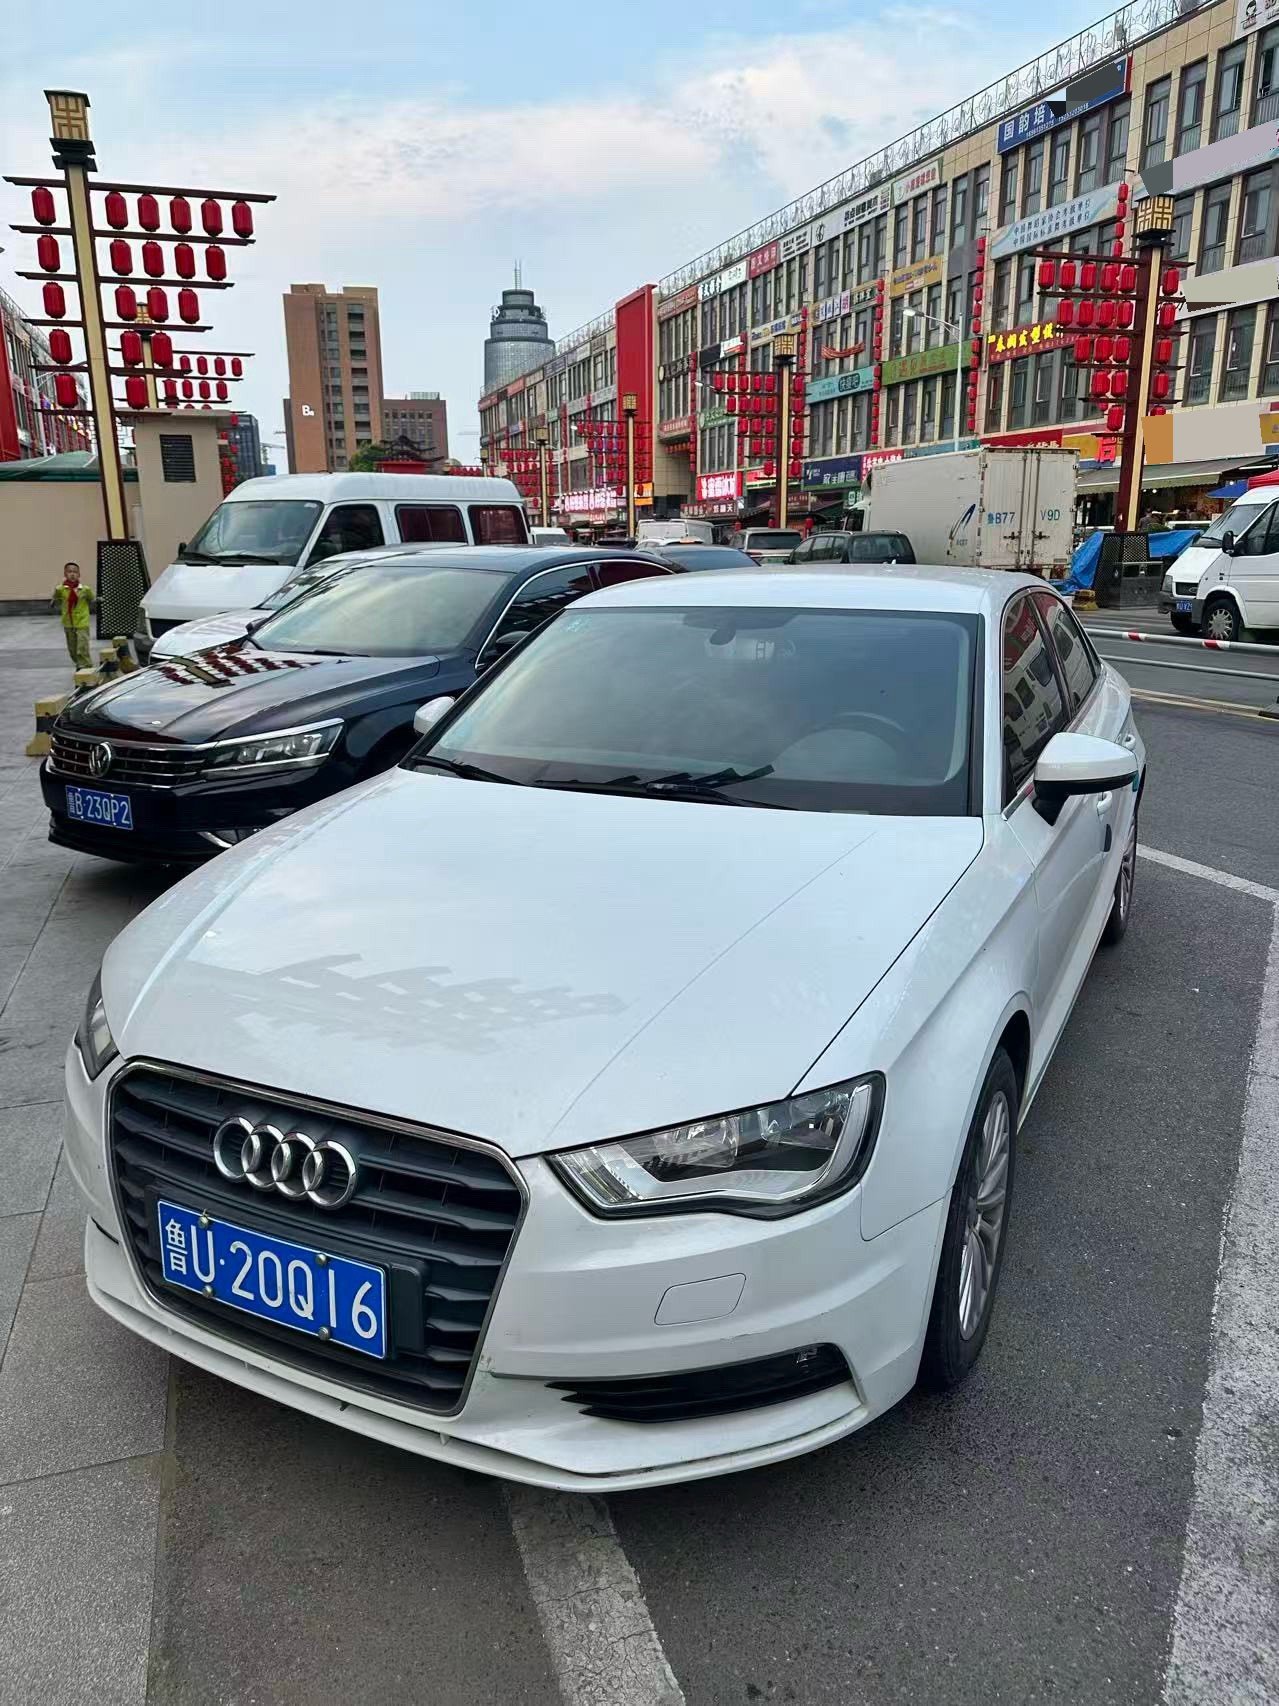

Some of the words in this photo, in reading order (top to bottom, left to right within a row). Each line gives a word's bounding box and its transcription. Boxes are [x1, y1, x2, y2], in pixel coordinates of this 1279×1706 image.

[1004, 104, 1055, 141] 国韵培
[1040, 509, 1061, 520] V9D
[165, 1218, 378, 1339] 鲁U·20Q16
